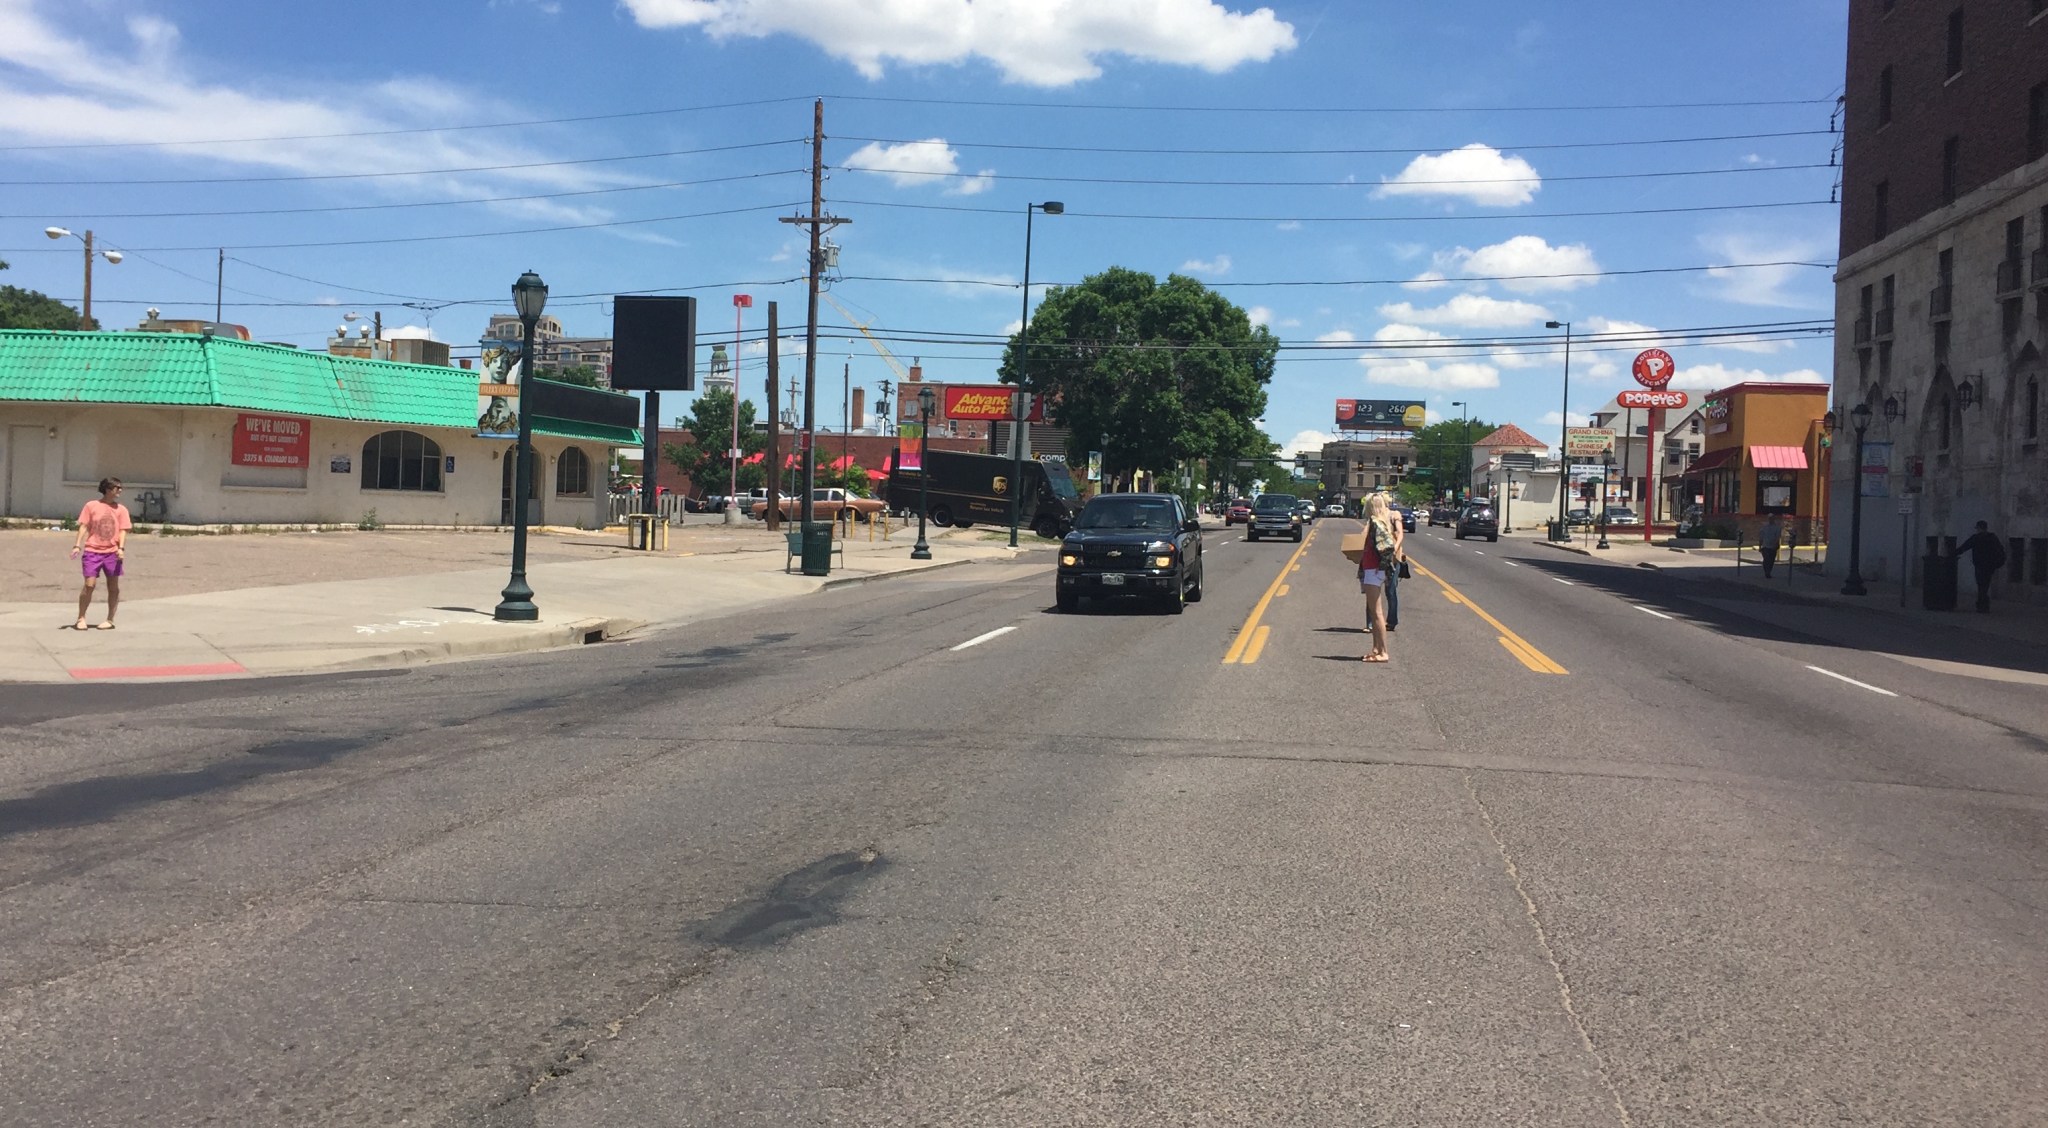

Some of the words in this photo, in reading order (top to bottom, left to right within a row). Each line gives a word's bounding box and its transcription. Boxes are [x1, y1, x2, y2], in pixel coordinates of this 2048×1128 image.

[1636, 350, 1673, 367] LOUISIANA
[1646, 358, 1665, 377] P
[1636, 373, 1670, 386] KITCHEN
[951, 404, 981, 413] Auto
[1358, 404, 1373, 412] 123
[1388, 405, 1406, 413] 260
[246, 417, 271, 433] WE'VE
[273, 420, 303, 436] MOVED,
[242, 453, 257, 462] 3375
